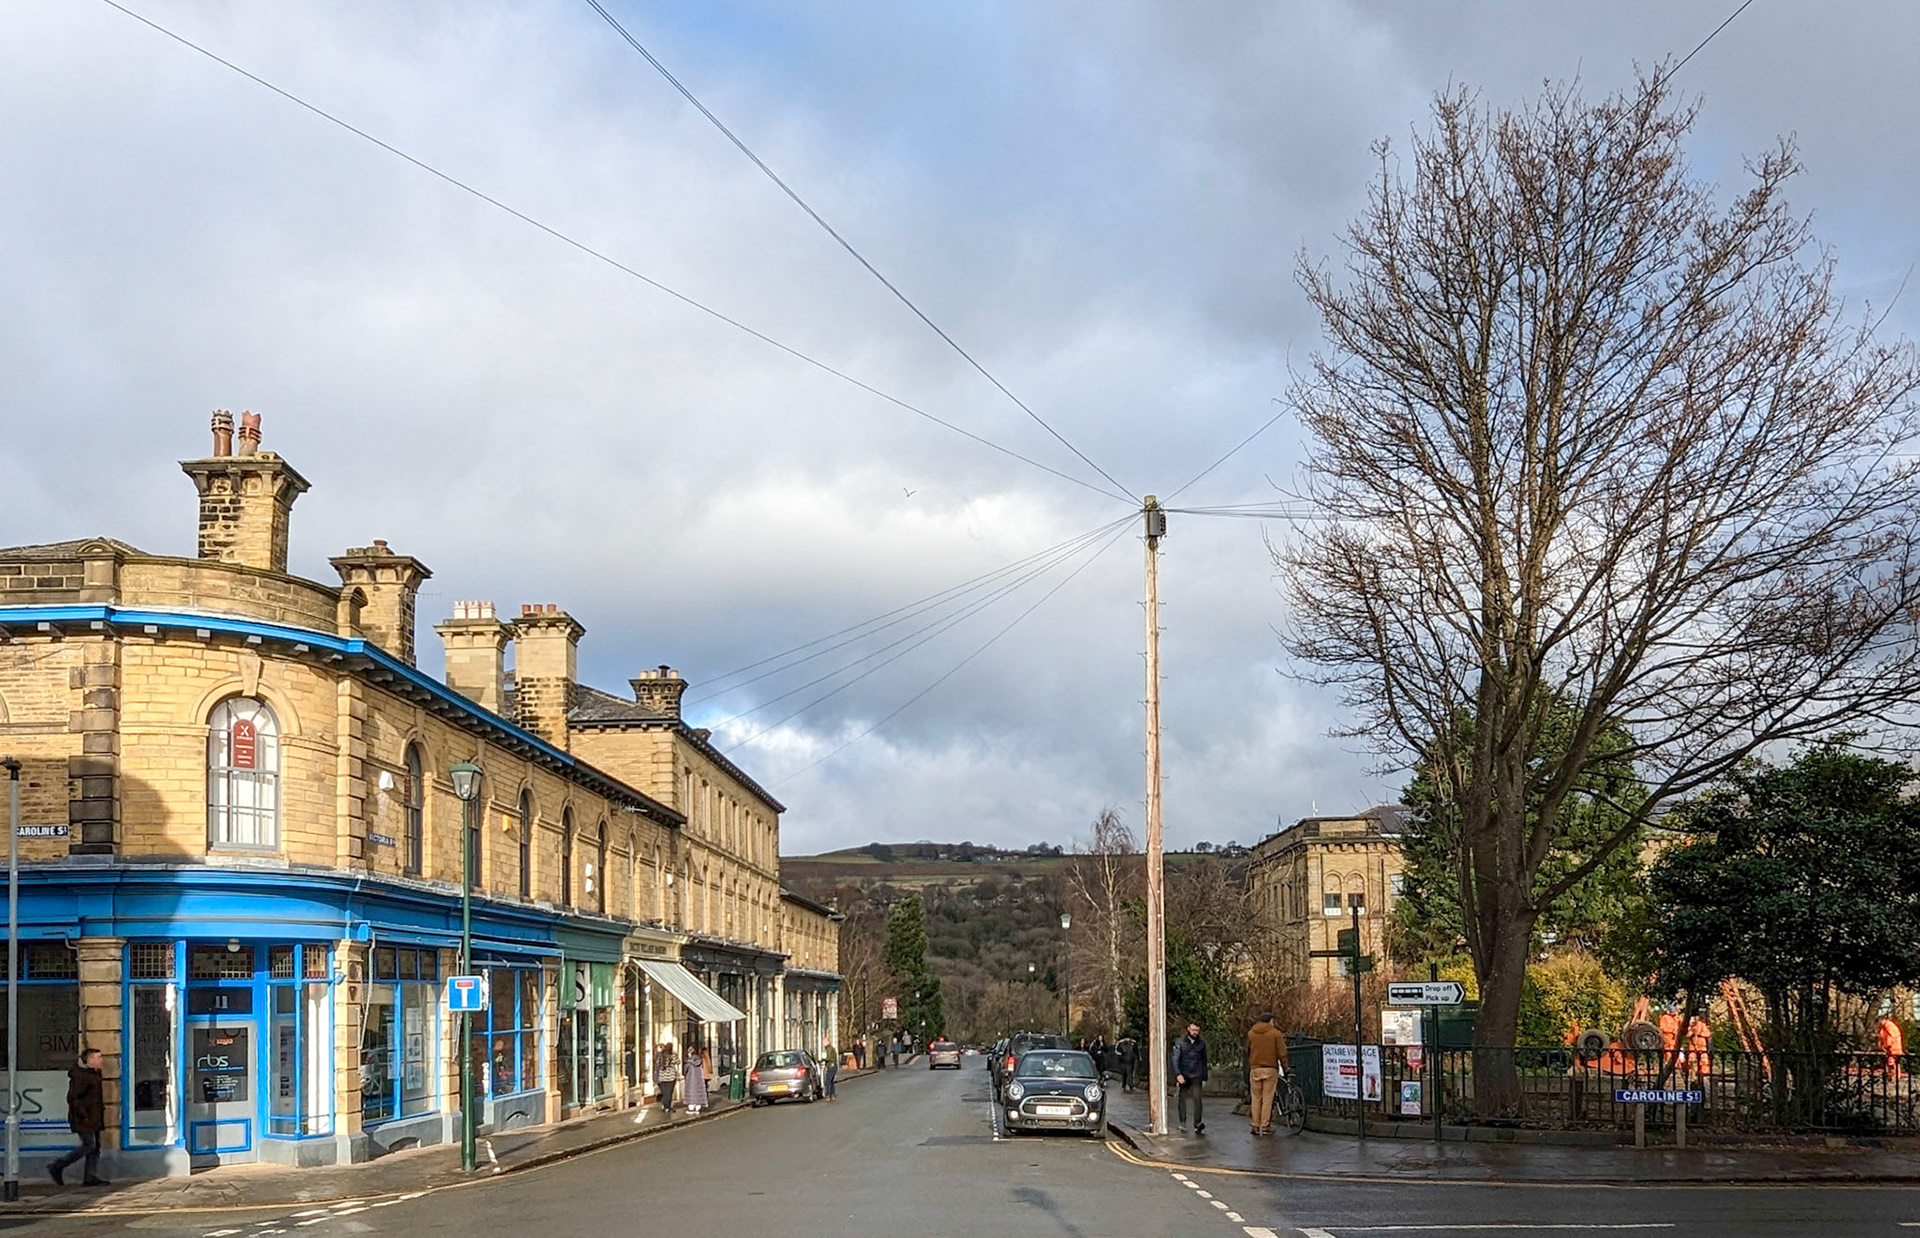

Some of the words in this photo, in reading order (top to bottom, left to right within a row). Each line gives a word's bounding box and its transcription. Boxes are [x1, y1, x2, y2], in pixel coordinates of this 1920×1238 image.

[215, 995, 229, 1009] 11
[40, 1034, 75, 1051] BIM
[197, 1053, 229, 1068] rbs
[1623, 1091, 1684, 1101] CAROLINE
